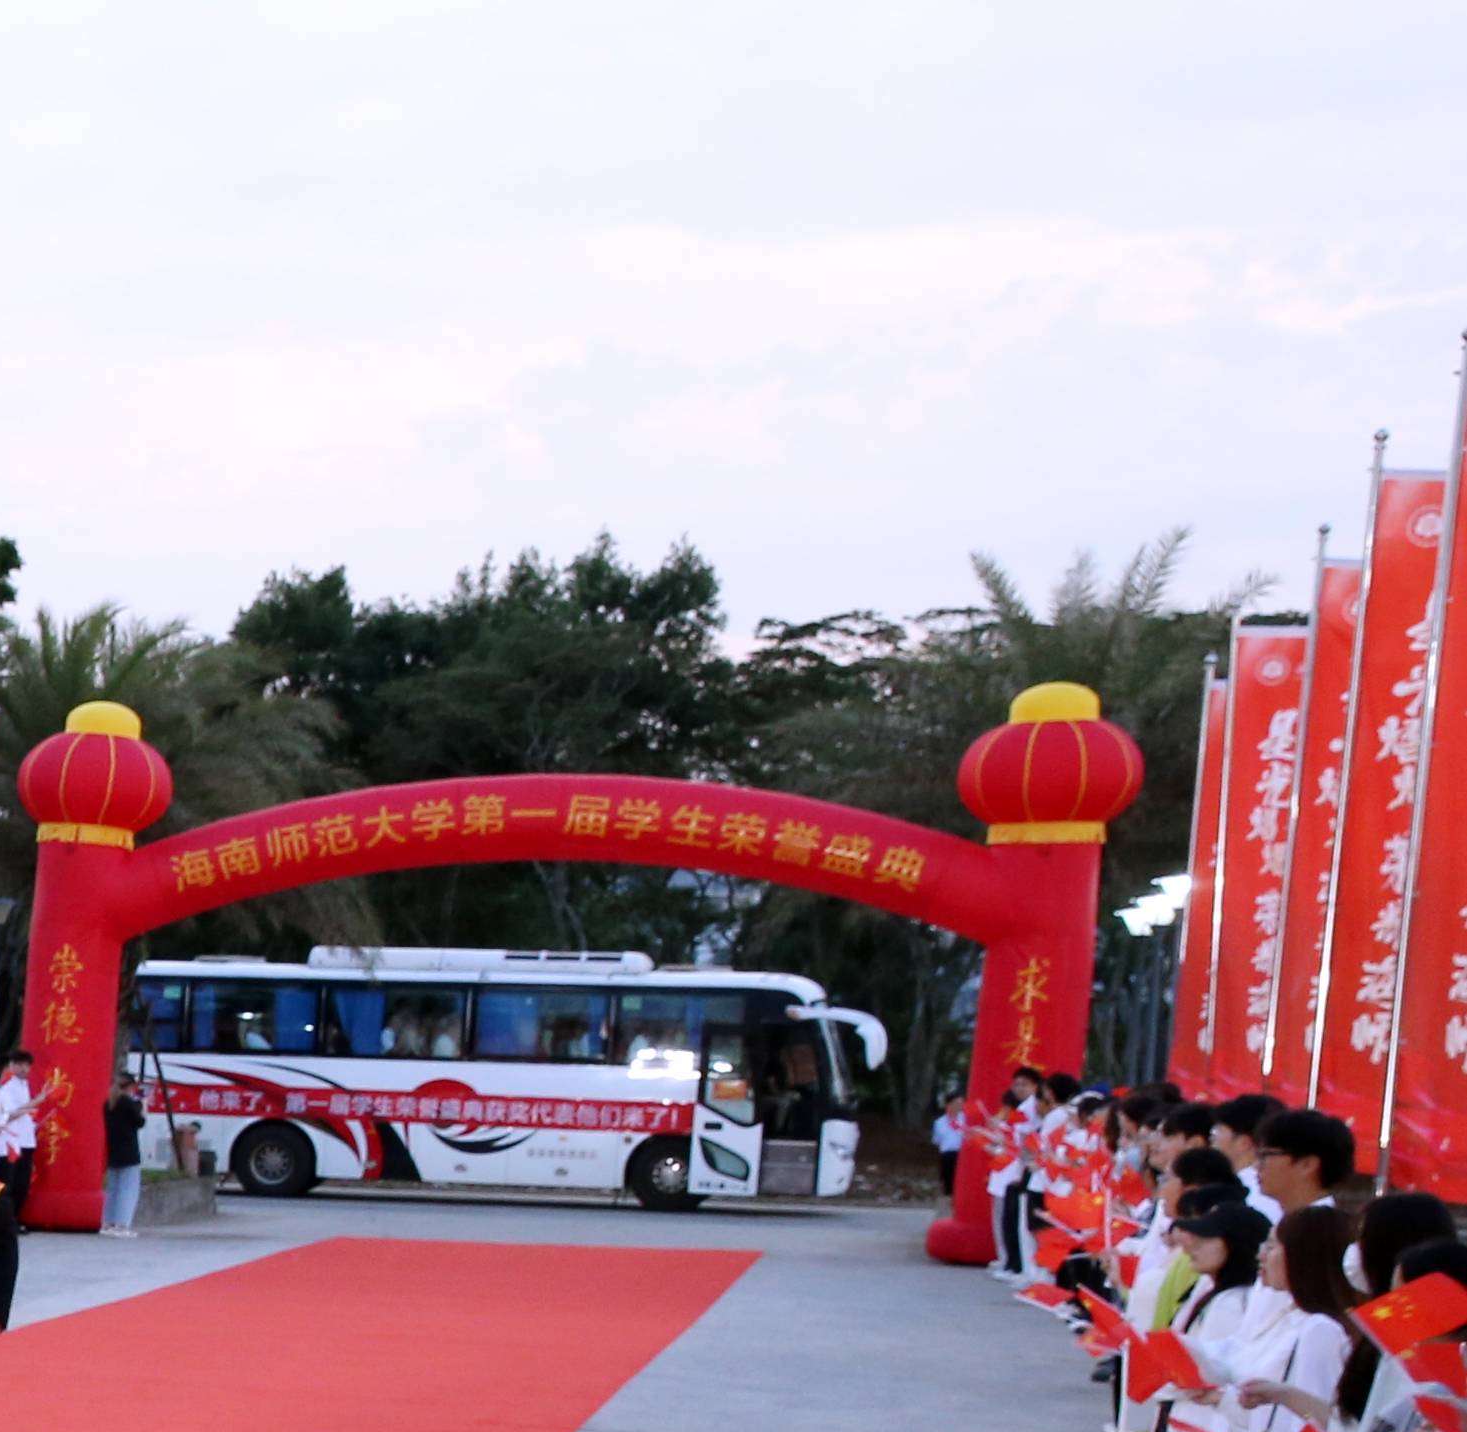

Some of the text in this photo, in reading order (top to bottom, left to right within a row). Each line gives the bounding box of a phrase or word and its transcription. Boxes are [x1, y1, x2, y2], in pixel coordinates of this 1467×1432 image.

[170, 794, 927, 893] 海南师范大学第一届学生荣誉盛典
